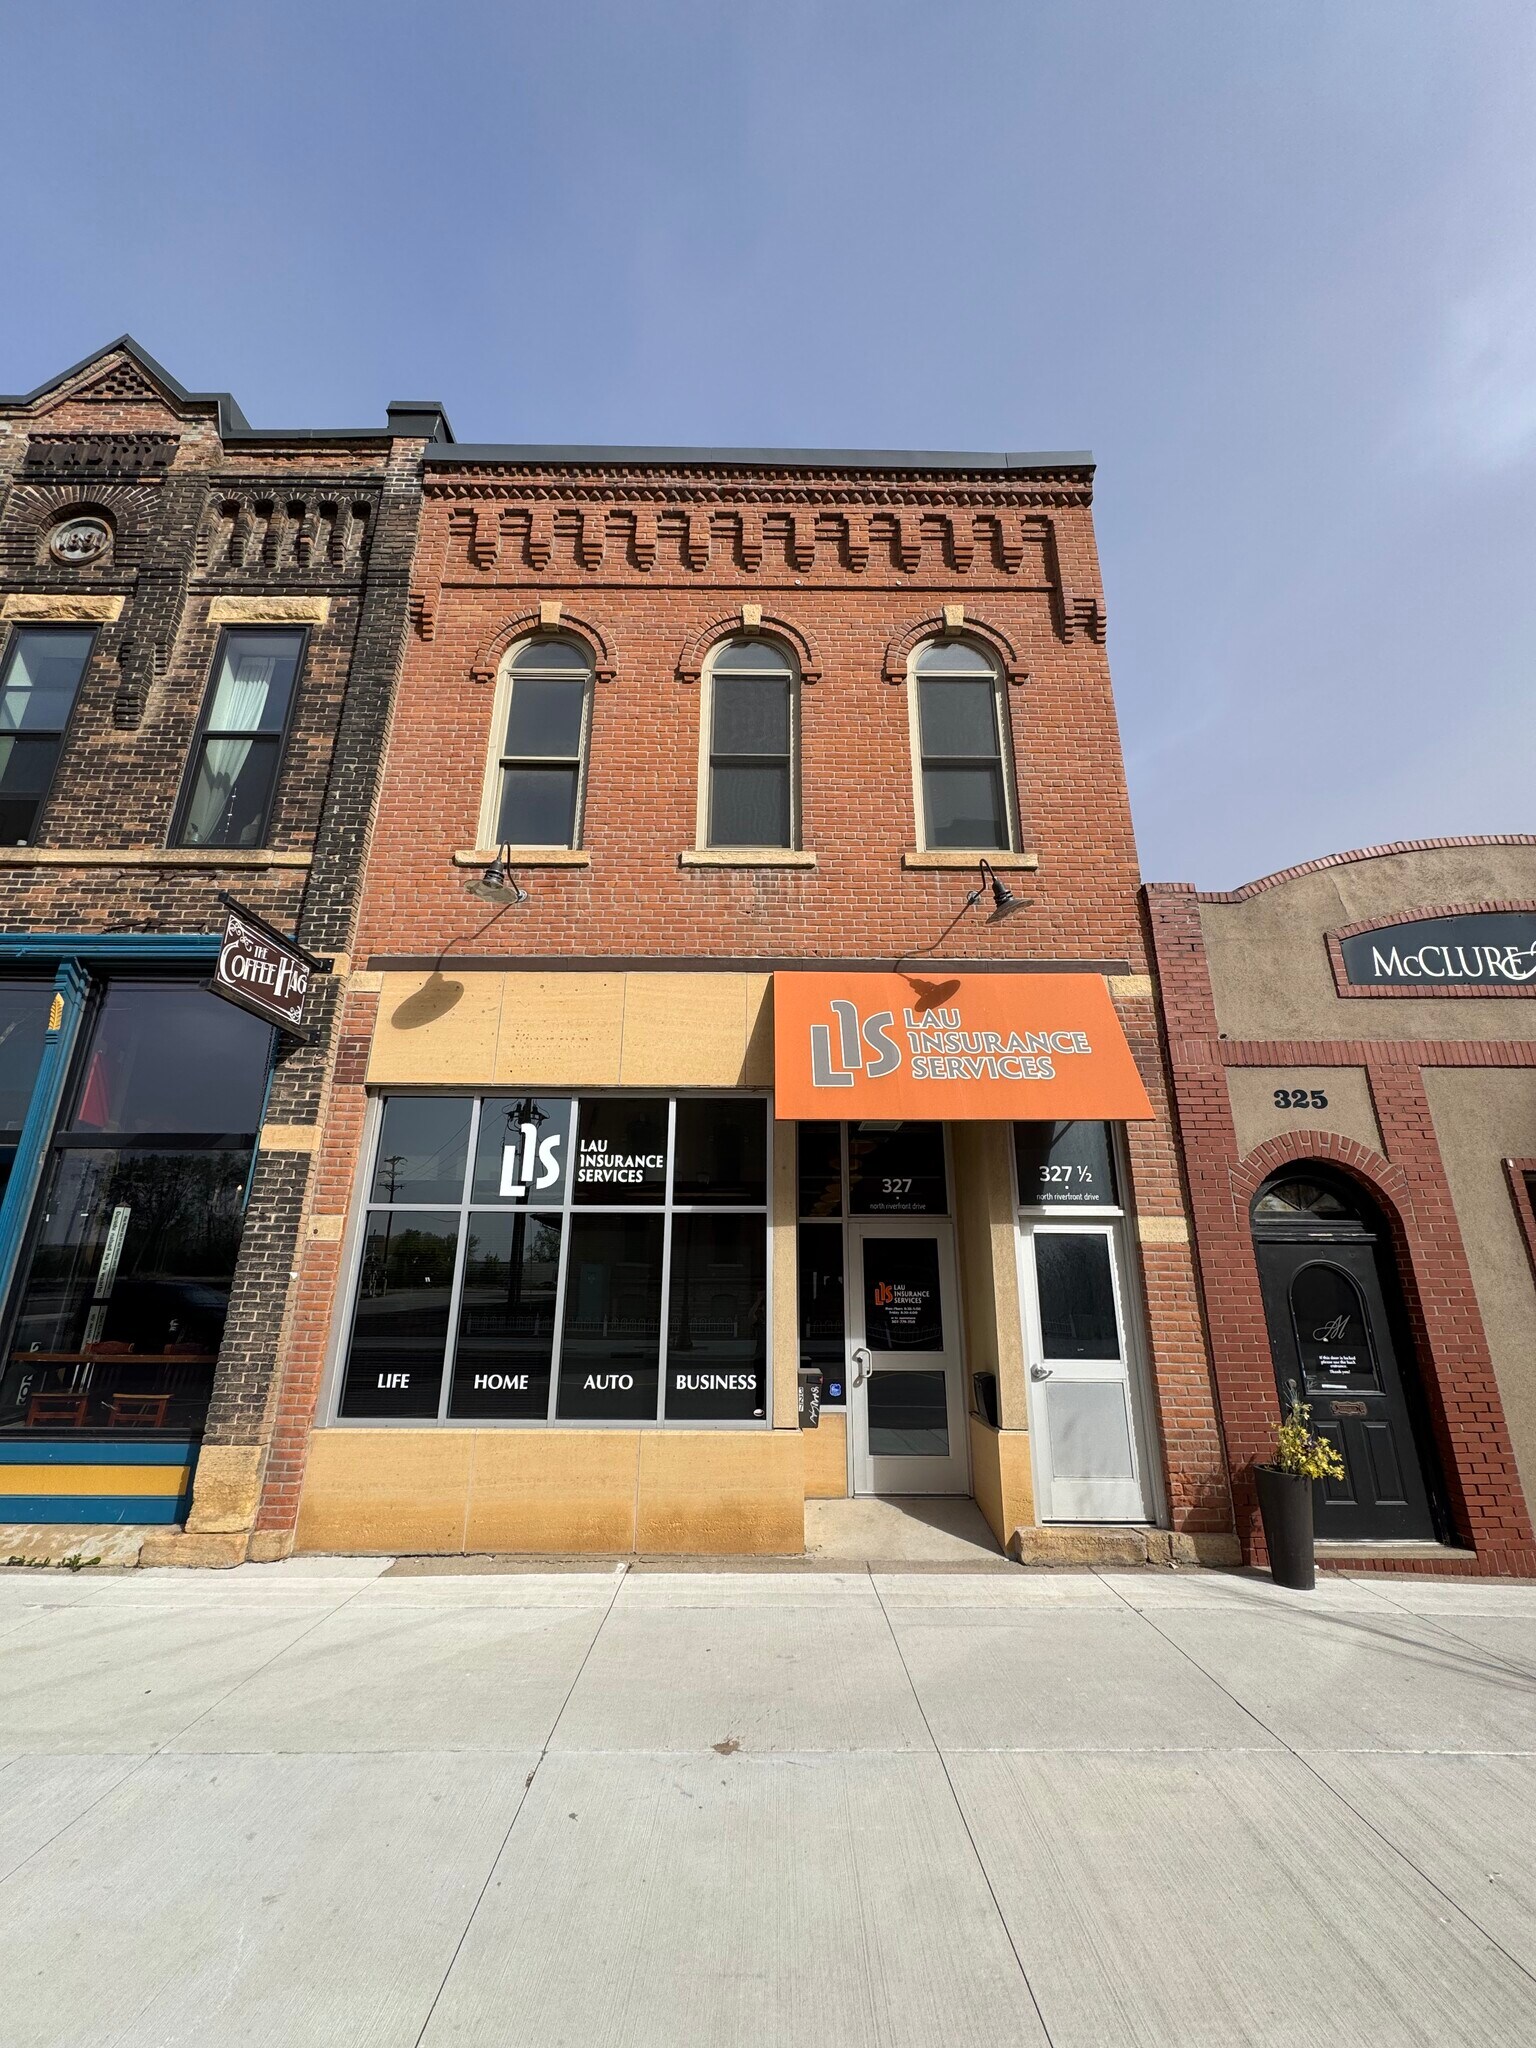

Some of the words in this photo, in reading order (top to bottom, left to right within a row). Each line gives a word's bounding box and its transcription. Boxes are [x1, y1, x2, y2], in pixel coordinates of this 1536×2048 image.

[254, 945, 269, 960] THE
[903, 1008, 961, 1030] LAU
[810, 1000, 901, 1087] LIS
[906, 1031, 1092, 1054] INSURANCE
[911, 1055, 1056, 1080] SERVICES
[1274, 1089, 1329, 1110] 325
[580, 1139, 608, 1153] LAU
[500, 1123, 561, 1197] LIS
[580, 1154, 664, 1168] INSURANCE
[577, 1169, 644, 1183] SERVICES
[1039, 1165, 1073, 1182] 327
[882, 1178, 912, 1193] 327
[1036, 1193, 1053, 1201] north
[1054, 1193, 1083, 1201] riverfront
[1084, 1193, 1100, 1201] drive
[377, 1373, 410, 1389] LIFE
[474, 1374, 529, 1390] HOME
[583, 1374, 634, 1390] AUTO
[676, 1374, 757, 1390] BUSINESS
